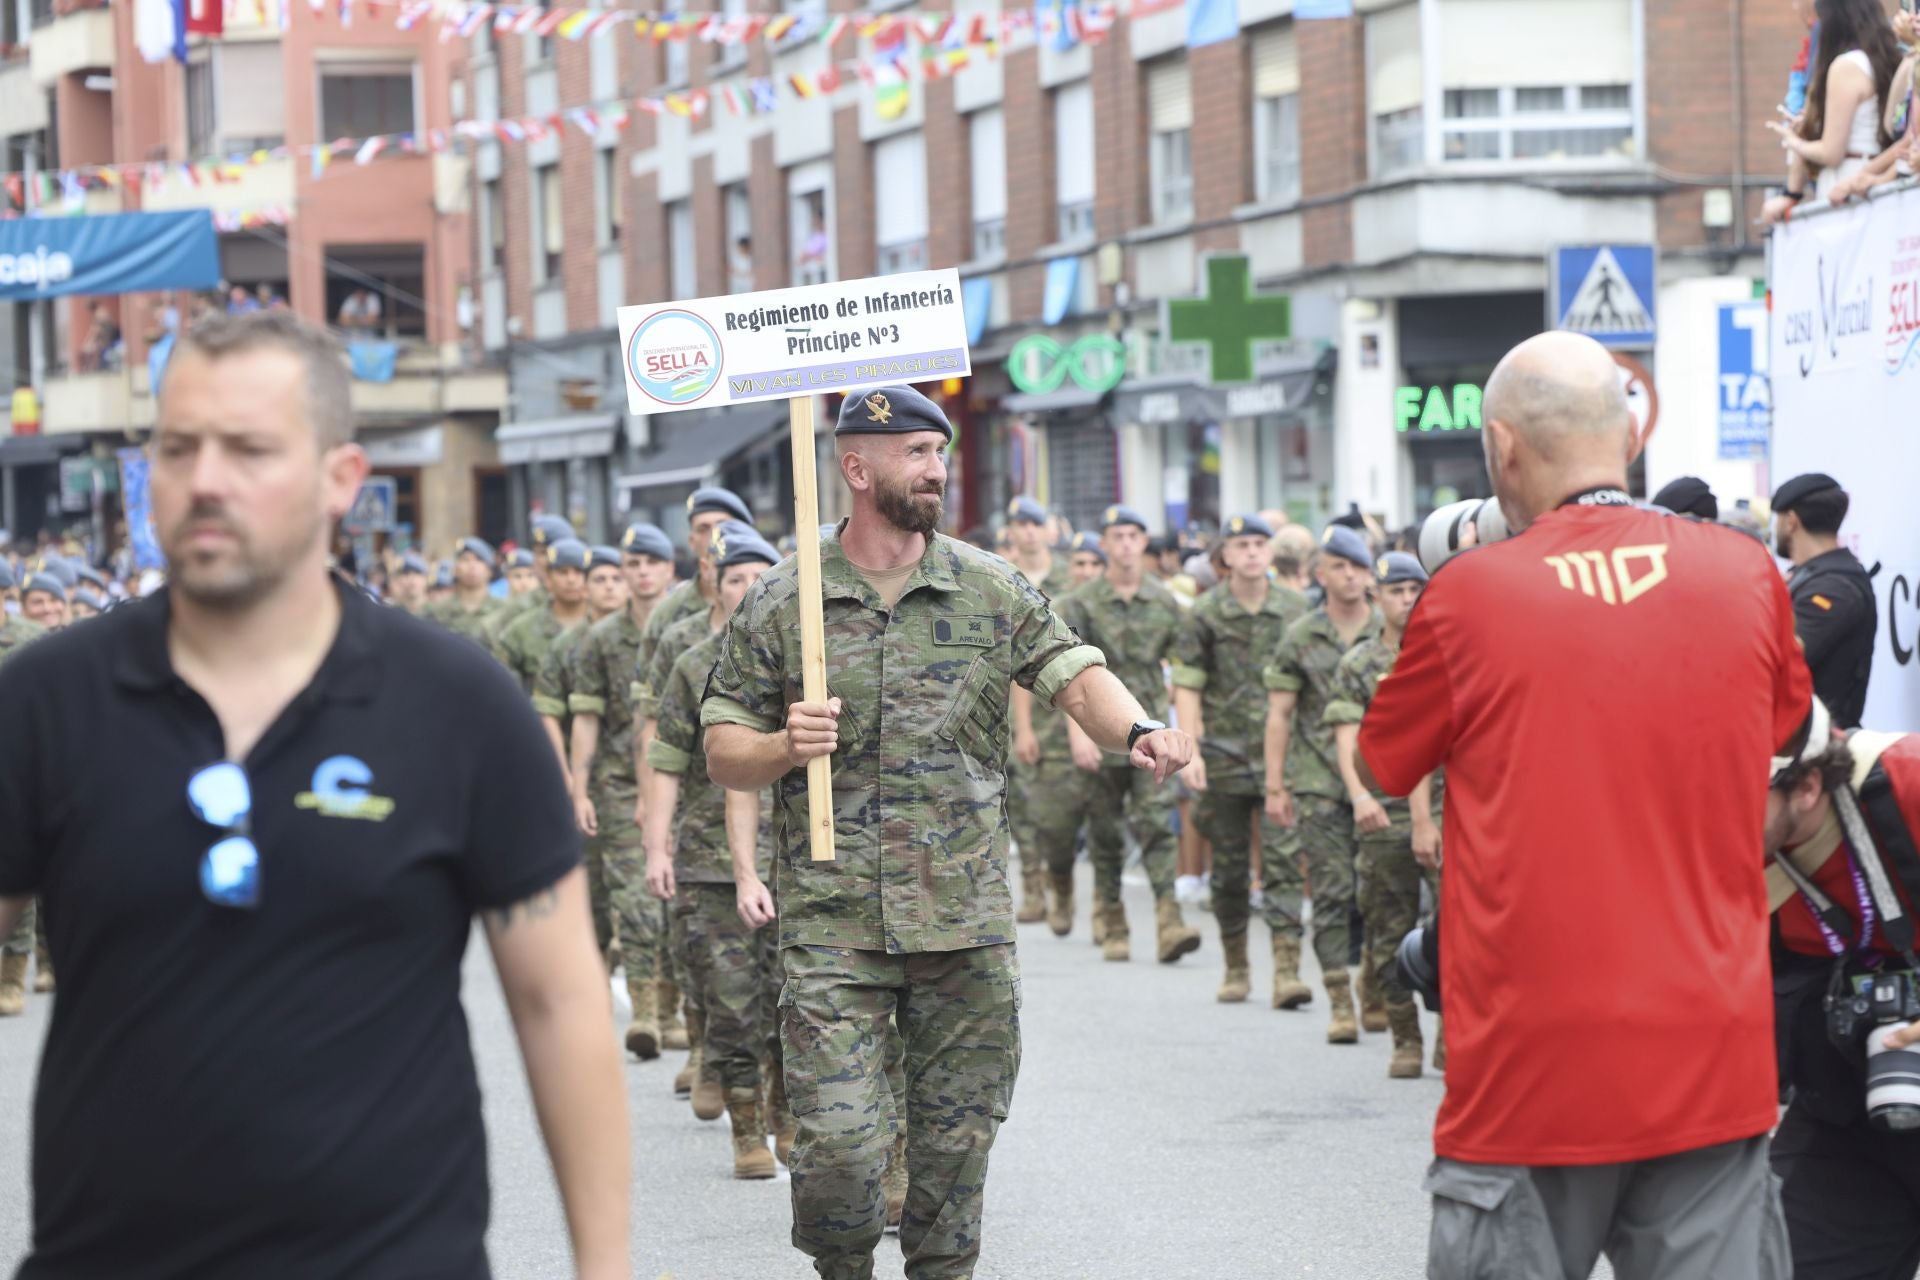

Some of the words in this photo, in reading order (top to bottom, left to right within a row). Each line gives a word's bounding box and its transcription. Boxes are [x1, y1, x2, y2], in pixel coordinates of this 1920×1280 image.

[724, 302, 829, 332] Regimiento
[836, 297, 858, 318] de
[865, 284, 954, 313] Infantería
[786, 328, 861, 355] Príncipe
[646, 350, 709, 373] SELLA
[730, 372, 802, 394] VIVAN
[809, 366, 848, 385] LES
[1395, 383, 1483, 432] FAR
[959, 635, 992, 645] AREVALO
